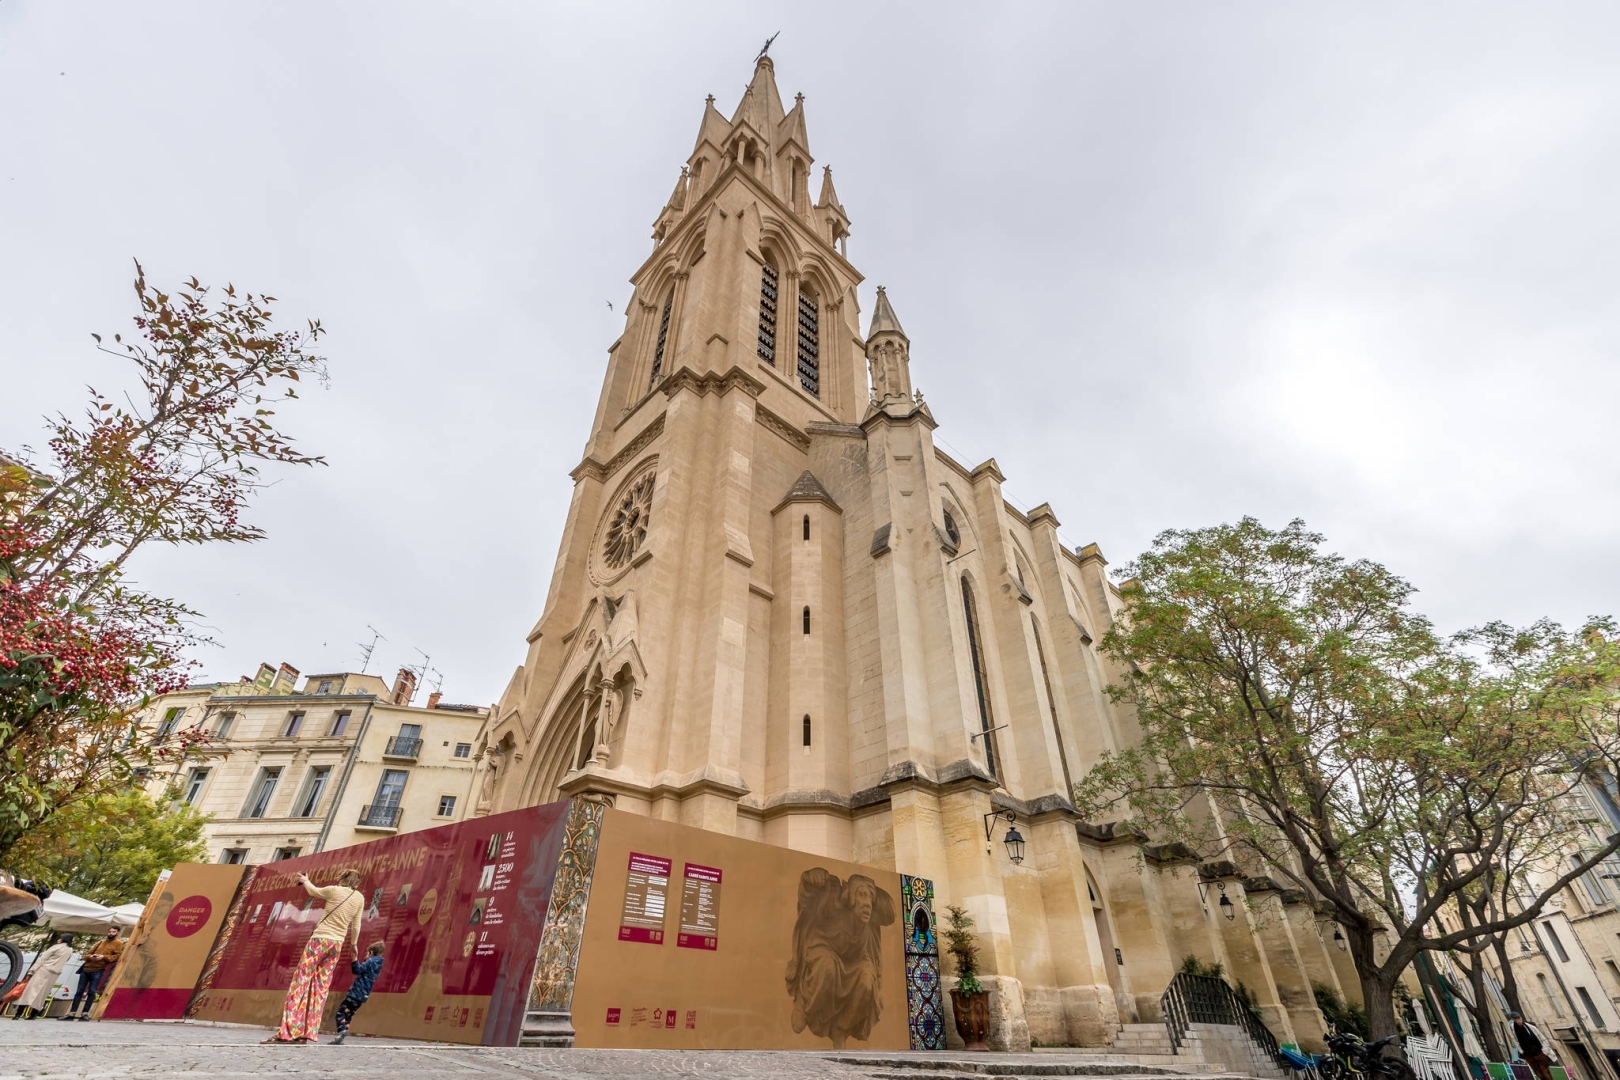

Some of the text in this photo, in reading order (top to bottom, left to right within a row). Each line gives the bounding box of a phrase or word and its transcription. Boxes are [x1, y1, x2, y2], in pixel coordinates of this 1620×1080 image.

[505, 831, 514, 841] 14
[251, 877, 267, 893] DE
[351, 846, 429, 876] SAINTE-ANNE
[496, 862, 514, 874] 2500
[488, 896, 494, 906] 9
